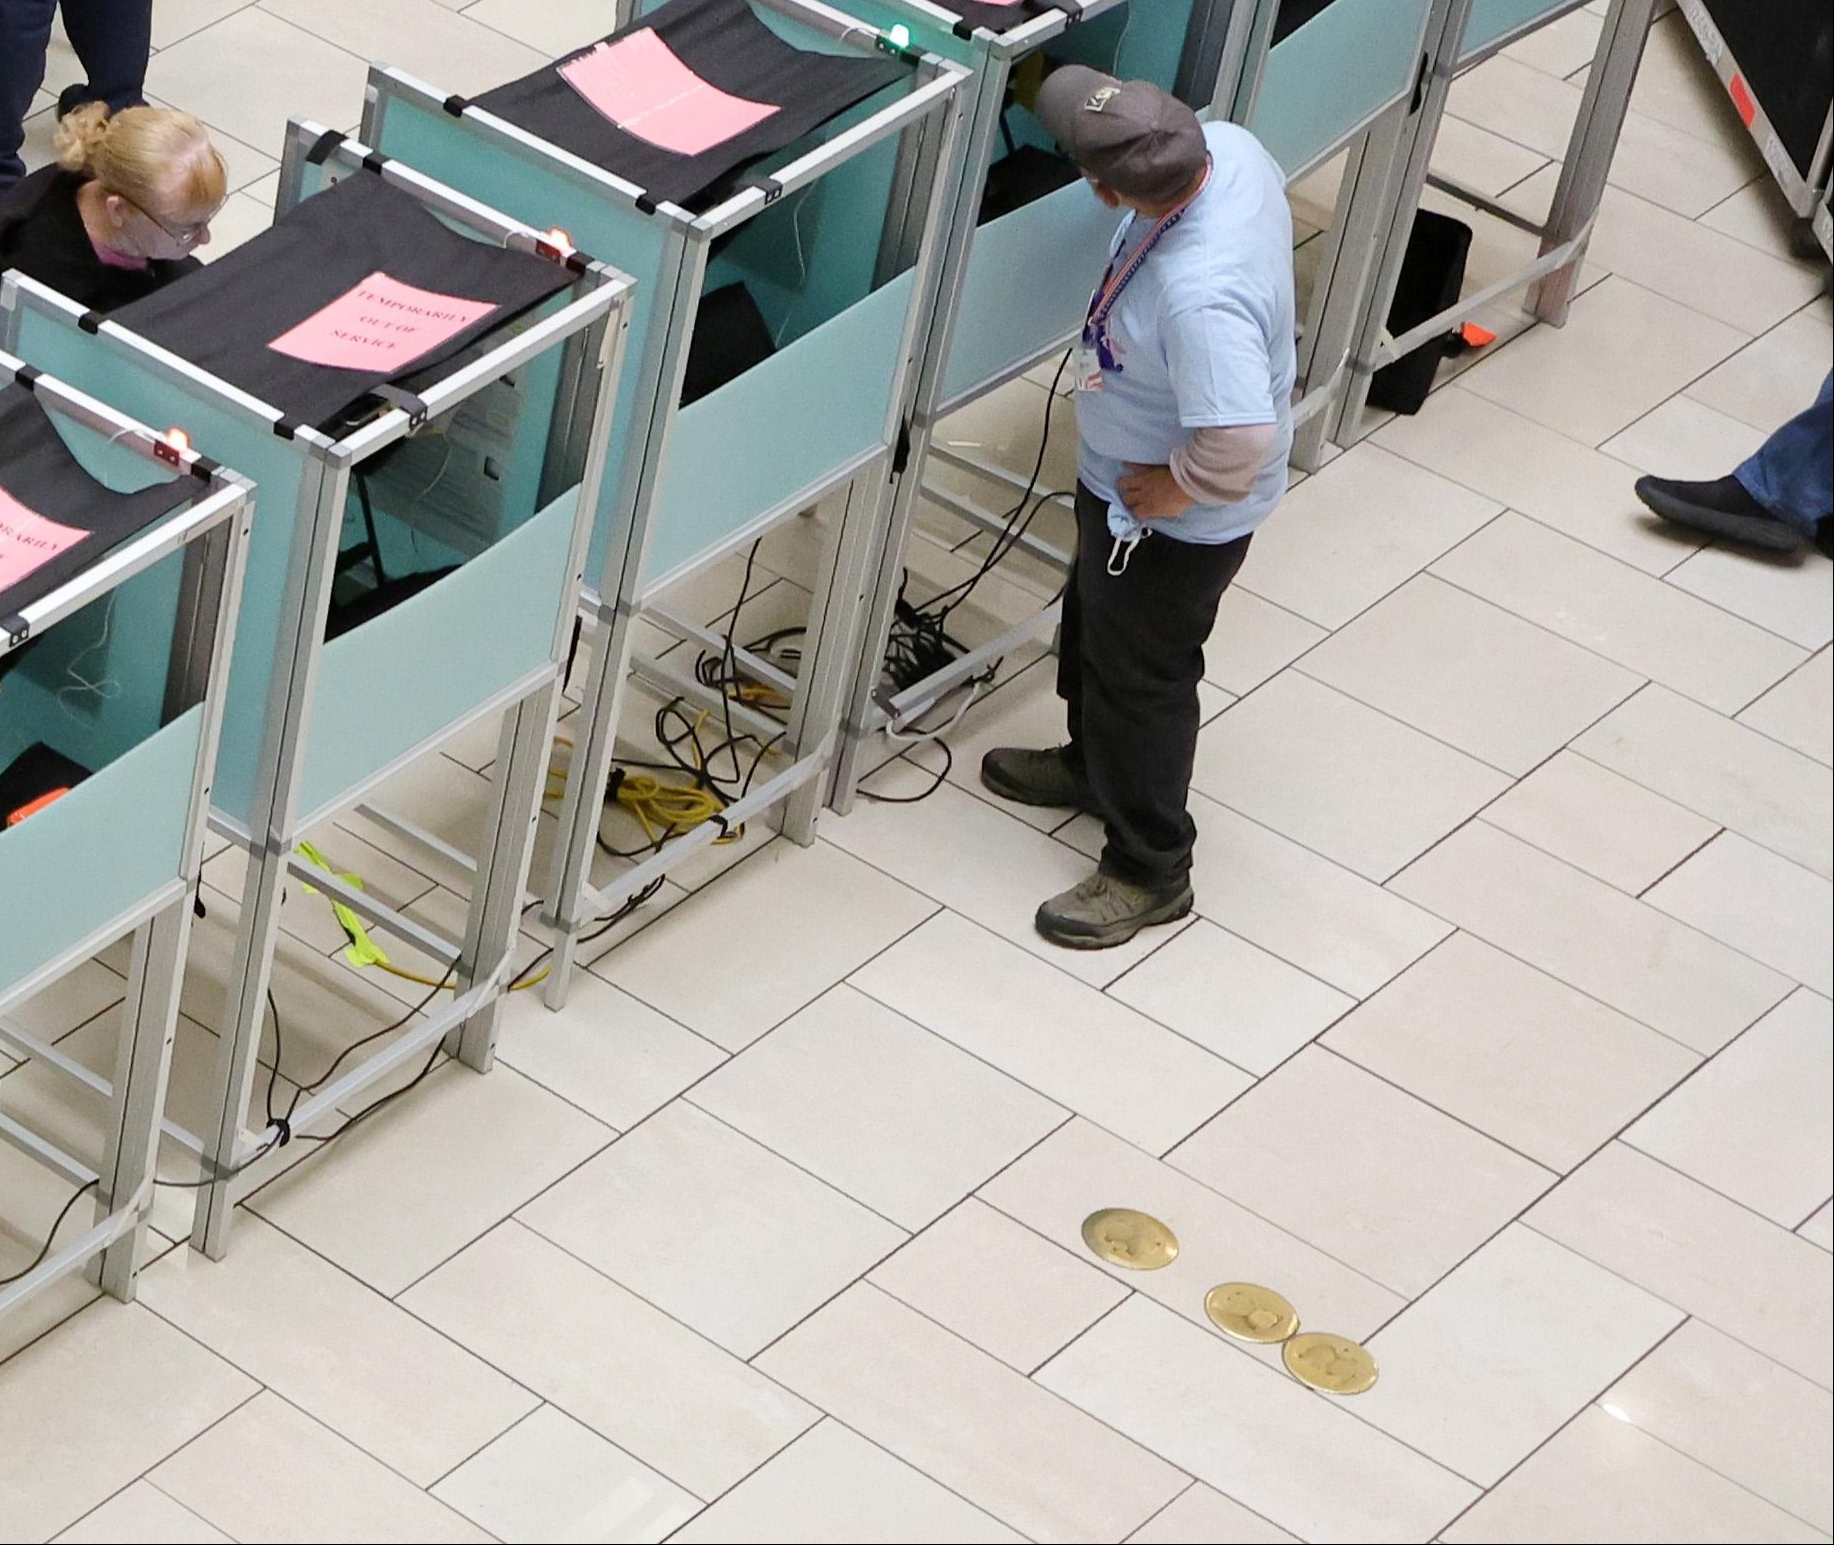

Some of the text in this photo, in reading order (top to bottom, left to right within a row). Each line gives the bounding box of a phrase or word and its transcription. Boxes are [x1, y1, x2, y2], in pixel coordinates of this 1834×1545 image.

[358, 290, 471, 323] TEMPORARILY
[360, 316, 418, 333] OUT OF
[331, 329, 397, 350] SERVICE
